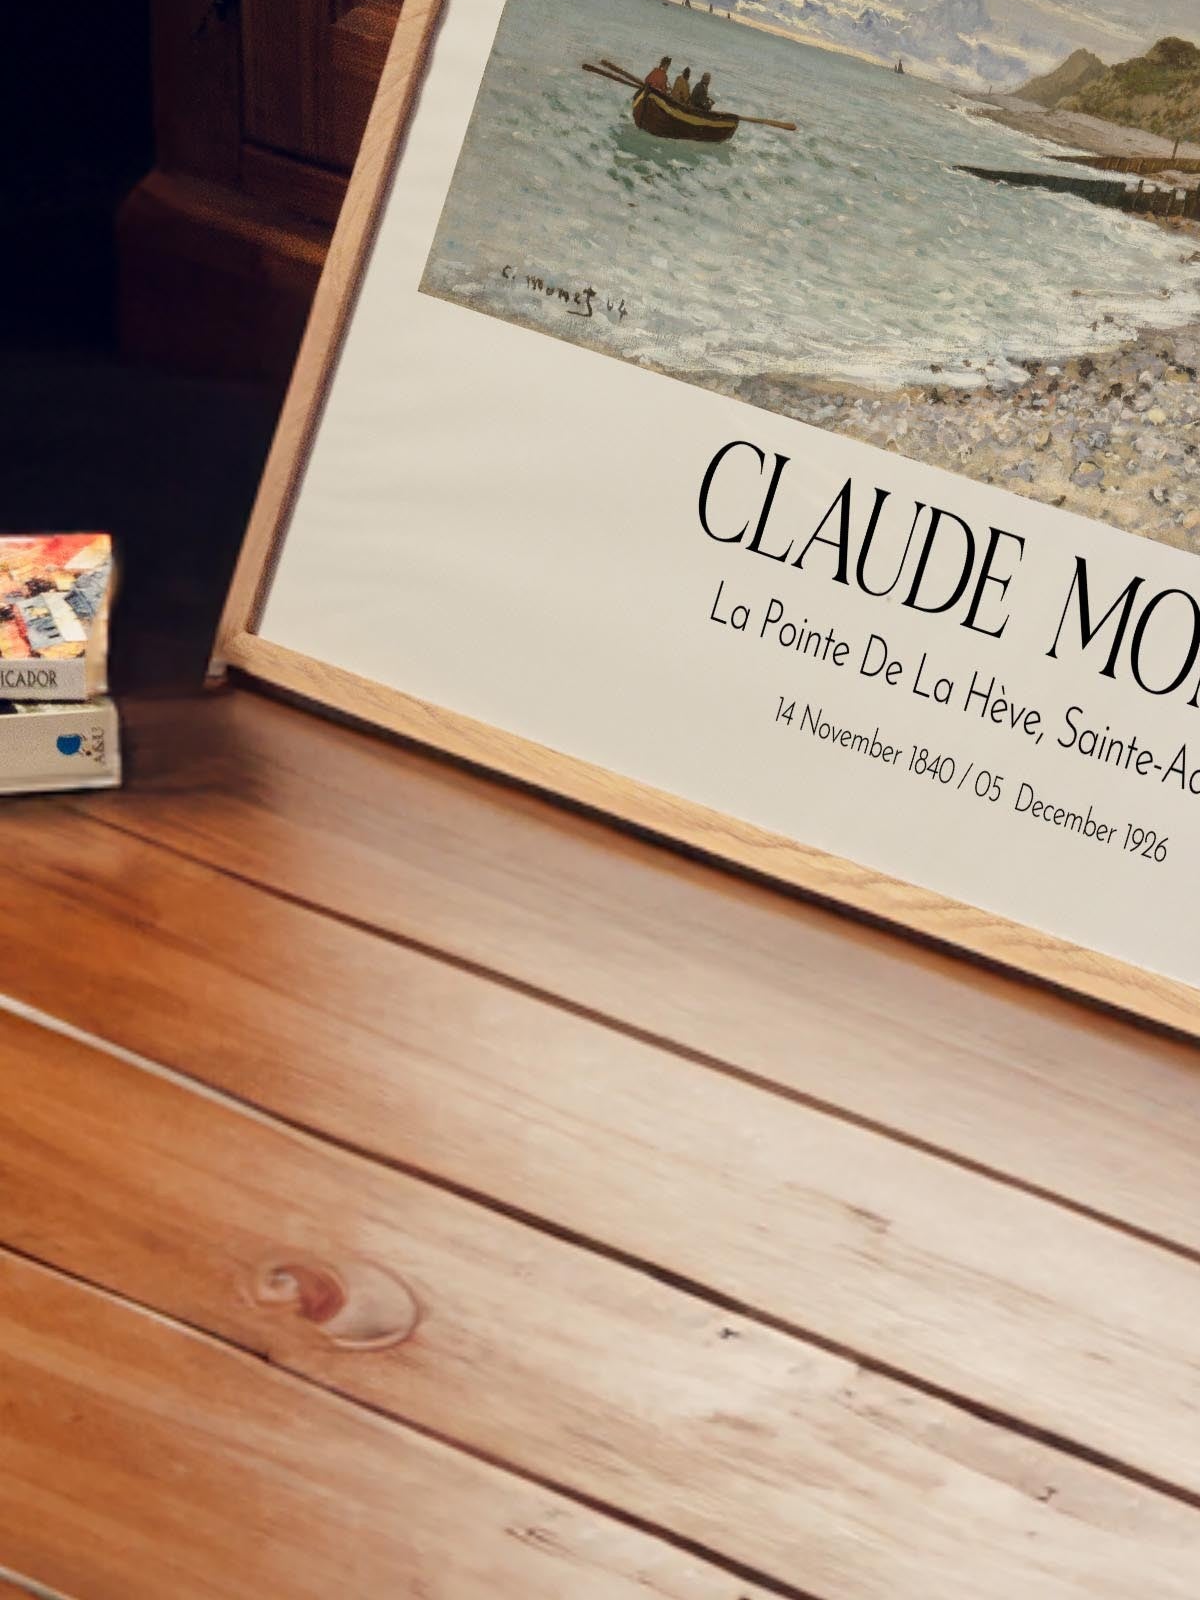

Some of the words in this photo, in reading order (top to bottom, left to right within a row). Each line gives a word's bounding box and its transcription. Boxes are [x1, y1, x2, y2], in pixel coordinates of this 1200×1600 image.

[698, 440, 1026, 639] CLAUDE
[0, 669, 58, 688] ICADOR
[709, 579, 751, 632] La
[759, 597, 850, 667] Pointe
[859, 633, 903, 686] De
[912, 652, 955, 705] La
[963, 670, 1045, 745] Hève,
[775, 695, 797, 726] 14
[799, 703, 903, 766] November
[908, 744, 956, 785] 1840
[956, 762, 974, 790] /
[974, 769, 1005, 803] 05
[1014, 781, 1118, 844] December
[1123, 822, 1169, 863] 1926
